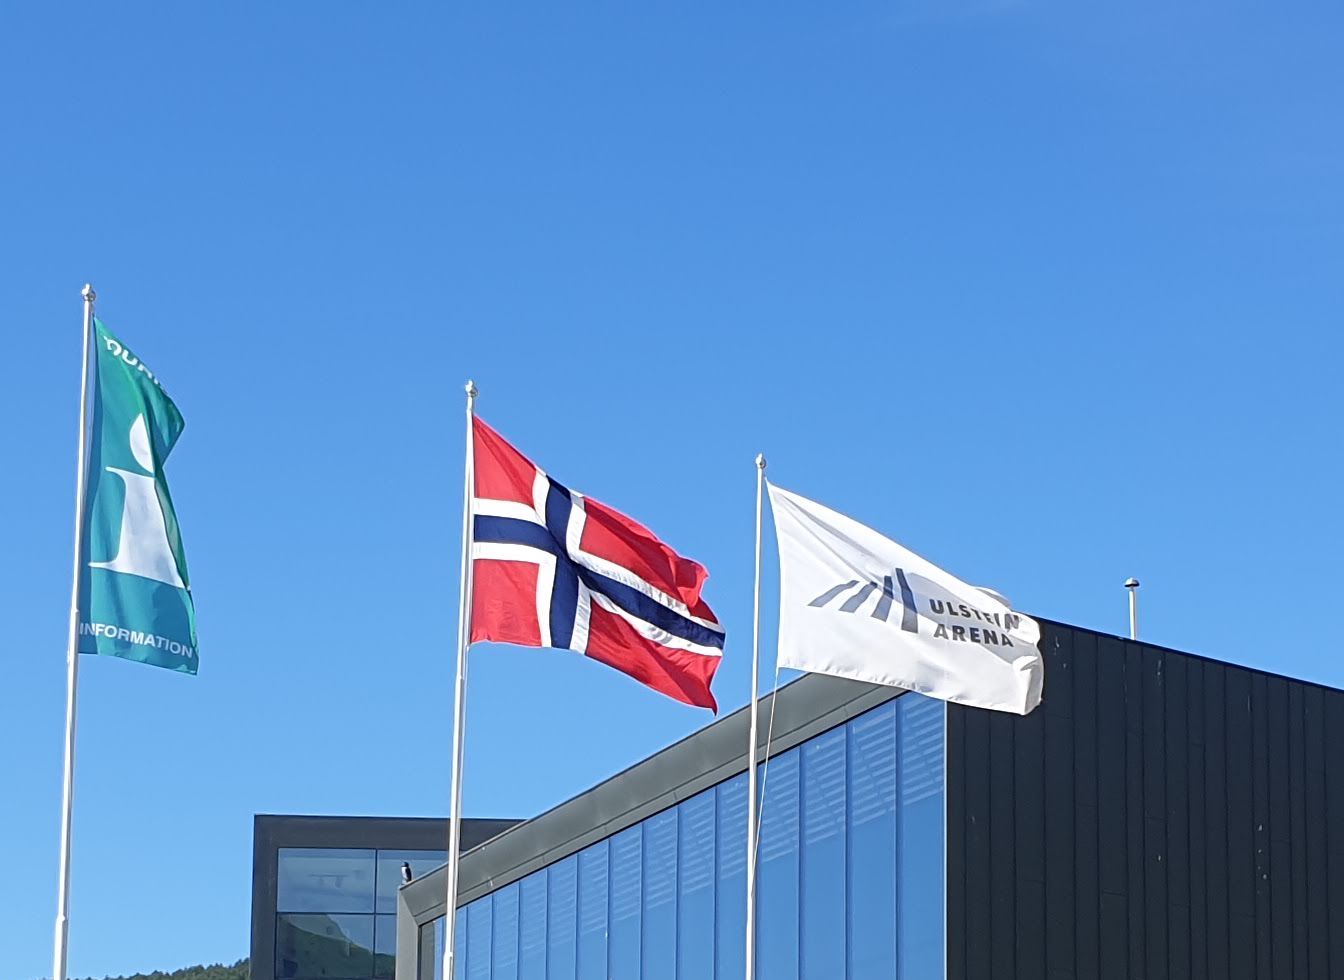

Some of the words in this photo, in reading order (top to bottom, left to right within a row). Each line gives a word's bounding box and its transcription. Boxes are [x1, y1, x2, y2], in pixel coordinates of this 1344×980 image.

[929, 599, 1020, 631] ULSTEIN
[79, 622, 193, 658] INFORMATION
[934, 623, 1014, 648] ARENA
